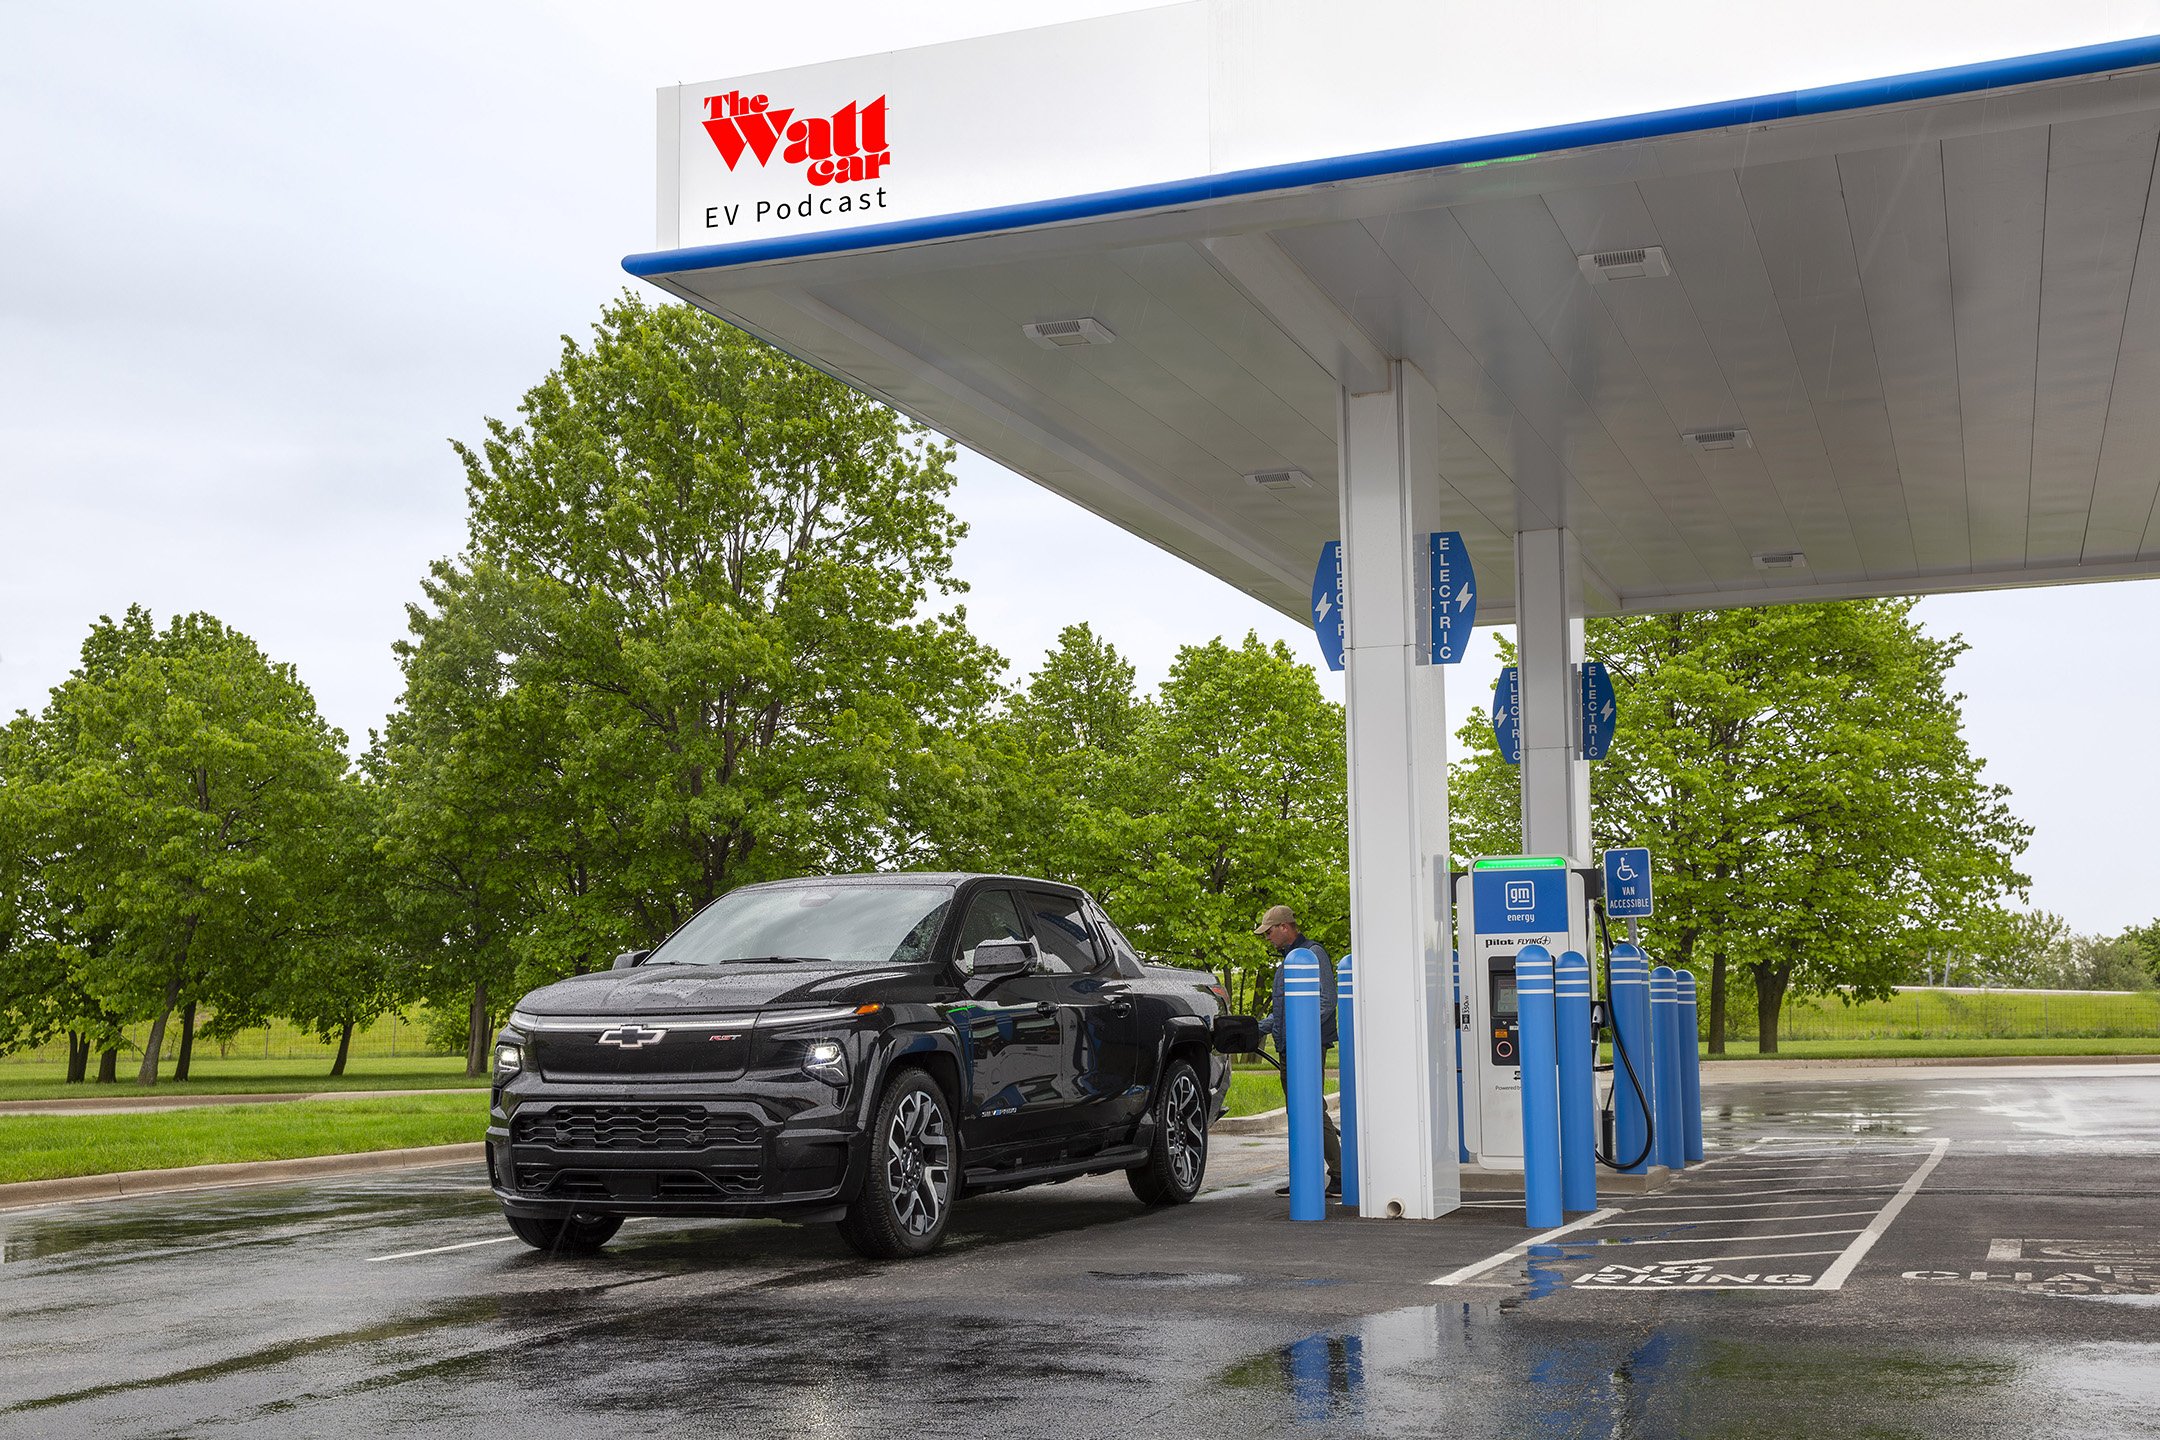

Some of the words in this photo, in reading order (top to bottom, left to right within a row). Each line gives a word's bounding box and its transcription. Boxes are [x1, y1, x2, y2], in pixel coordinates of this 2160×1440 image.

[703, 90, 769, 119] The
[701, 94, 890, 172] Watt
[807, 151, 890, 186] car
[706, 204, 739, 228] EV
[757, 187, 887, 222] Podcast
[1439, 537, 1451, 660] ELECTRIC
[1509, 671, 1520, 760] ELECTRIC
[1588, 666, 1598, 757] ELECTRIC
[1510, 887, 1530, 903] gm
[1609, 898, 1649, 909] ACCESSIBLE
[1622, 886, 1635, 896] VAN
[1507, 913, 1535, 923] energy
[1599, 1264, 1714, 1274] NO
